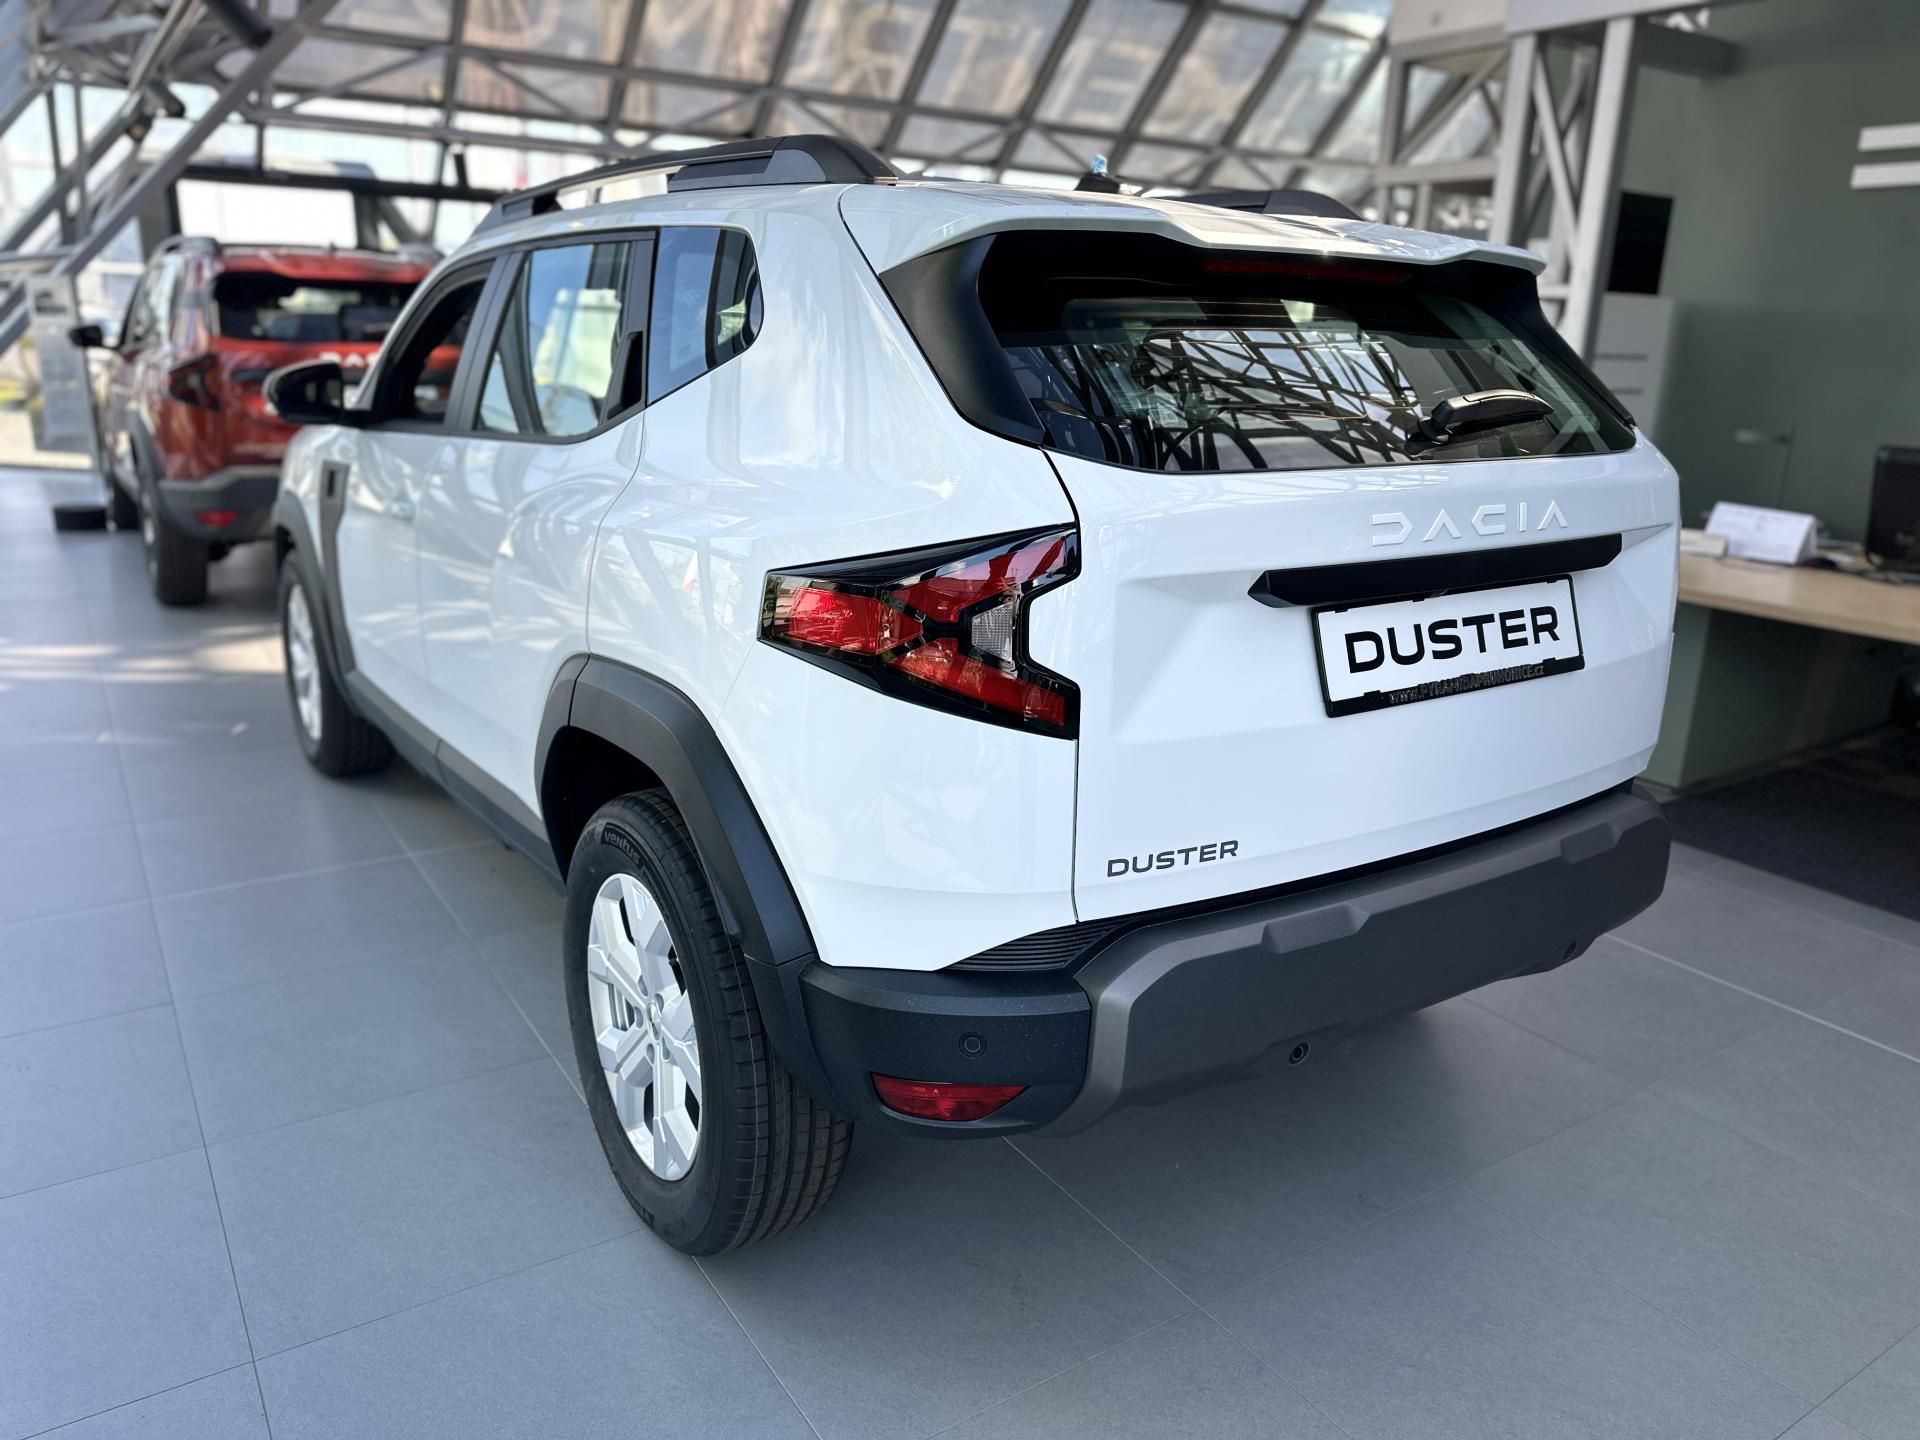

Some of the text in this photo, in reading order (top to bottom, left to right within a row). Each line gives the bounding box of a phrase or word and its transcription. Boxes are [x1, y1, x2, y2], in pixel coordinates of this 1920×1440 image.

[1371, 500, 1568, 547] DACIA
[1345, 606, 1560, 673] DUSTER
[1107, 839, 1239, 878] DUSTER
